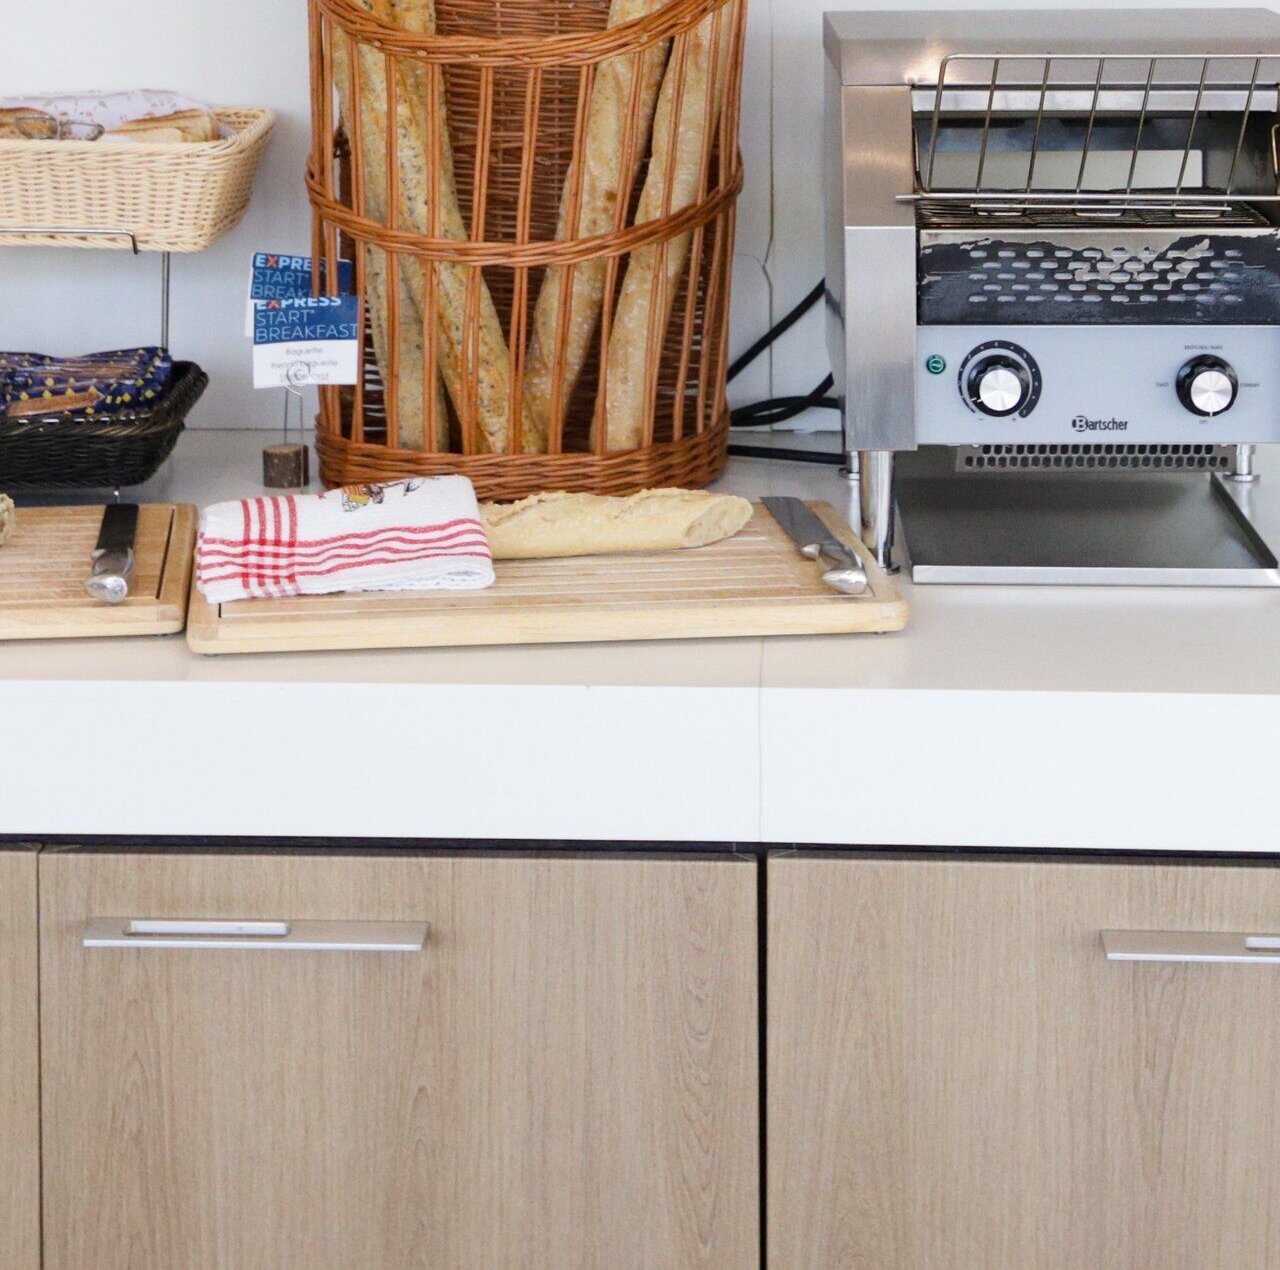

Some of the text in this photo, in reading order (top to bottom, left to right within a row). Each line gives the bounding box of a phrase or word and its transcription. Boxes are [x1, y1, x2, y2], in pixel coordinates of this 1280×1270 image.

[252, 269, 310, 286] START
[256, 309, 315, 327] START
[256, 322, 358, 343] BREAKFAST
[286, 346, 323, 356] Baguette
[1071, 415, 1128, 433] Bartscher
